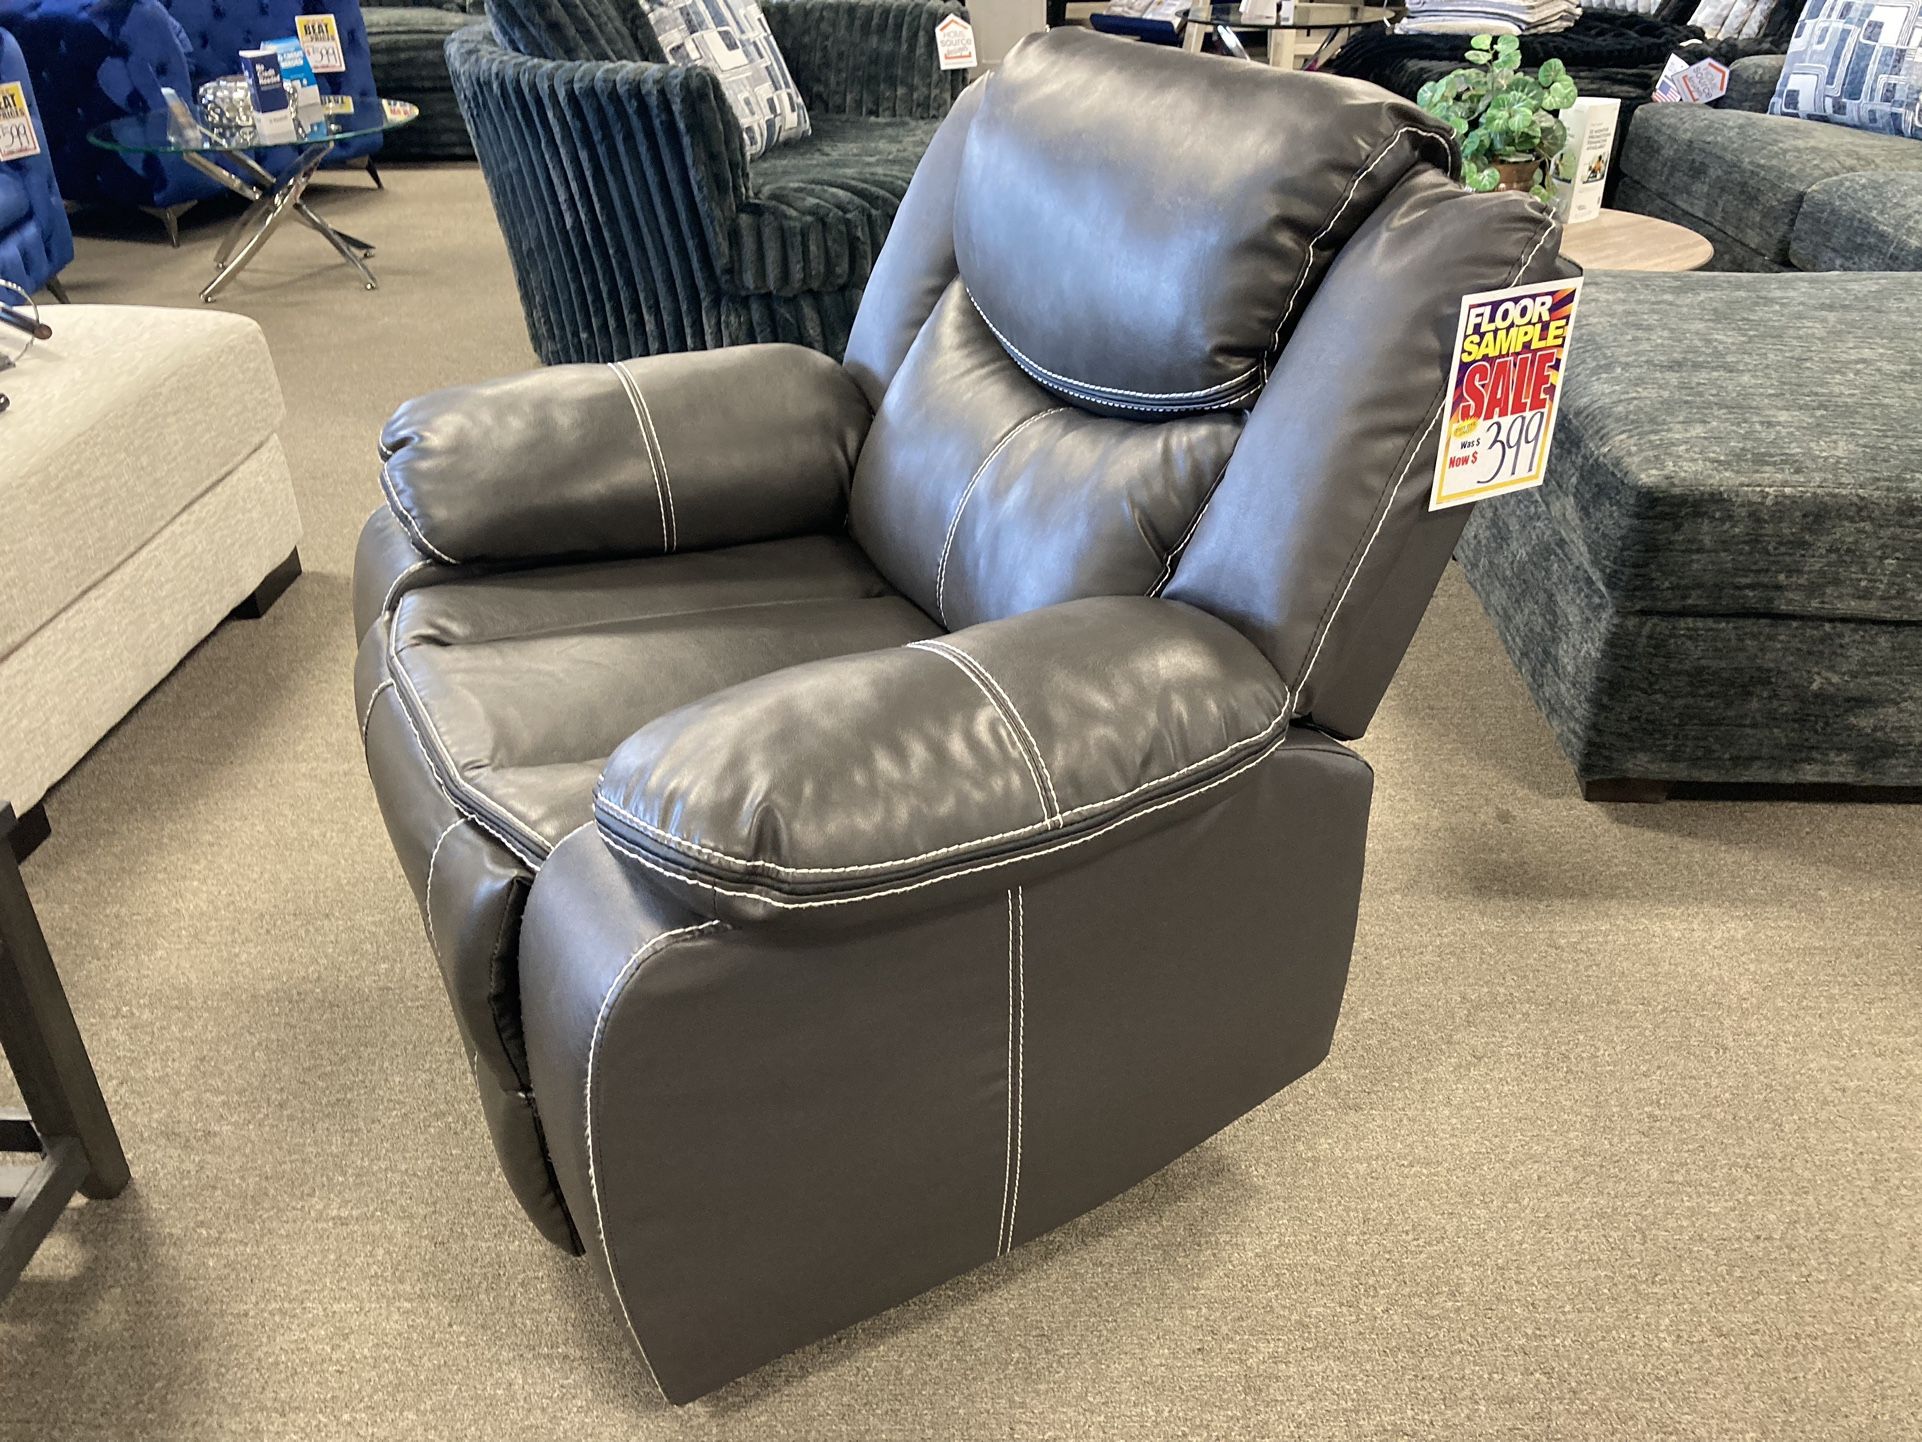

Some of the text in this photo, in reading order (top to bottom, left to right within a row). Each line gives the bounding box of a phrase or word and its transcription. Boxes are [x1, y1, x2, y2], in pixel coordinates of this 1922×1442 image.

[303, 22, 329, 36] BEAT
[1466, 295, 1554, 335] FLOOR
[1461, 319, 1567, 363] SAMPLE
[1459, 350, 1556, 422] SALE
[1449, 455, 1470, 469] Now
[1461, 440, 1475, 450] Was
[1476, 411, 1545, 484] 399
